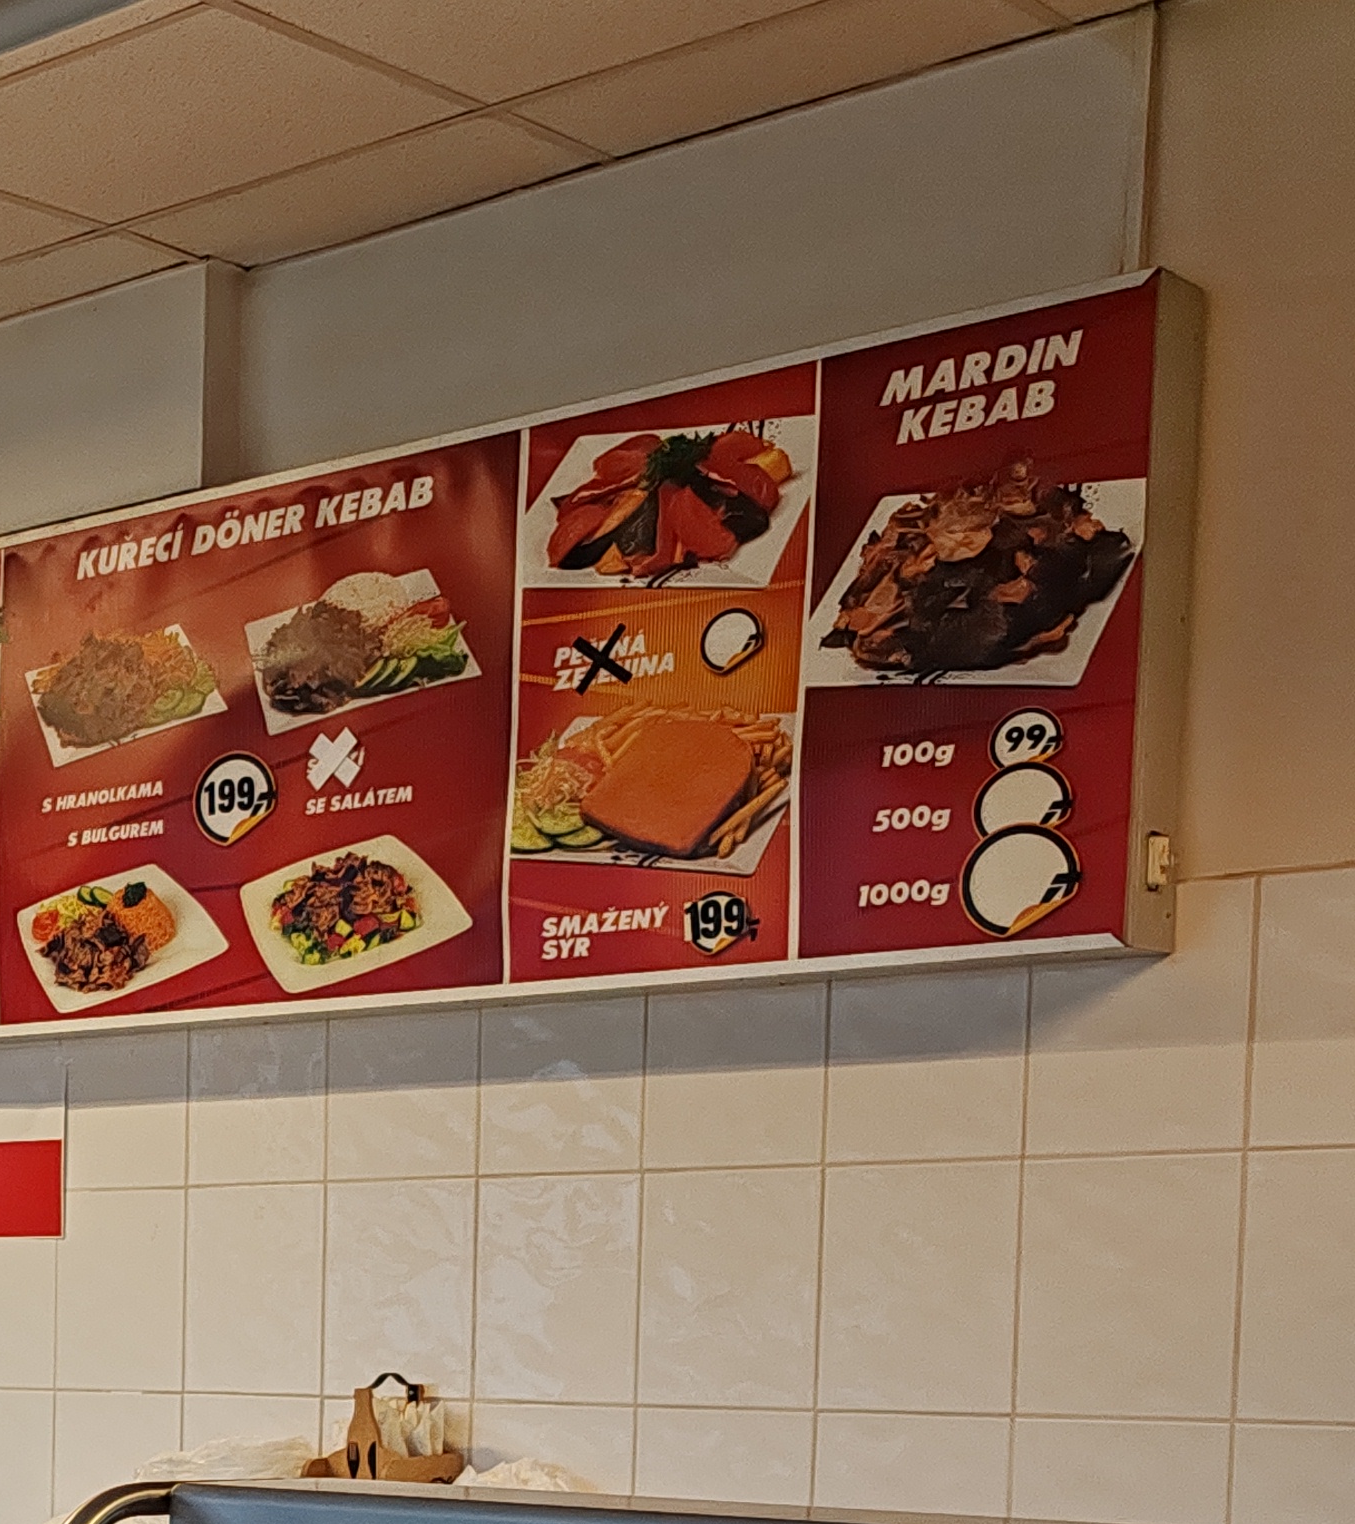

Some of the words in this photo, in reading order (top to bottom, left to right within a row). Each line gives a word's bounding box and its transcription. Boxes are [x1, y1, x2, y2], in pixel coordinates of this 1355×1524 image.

[879, 329, 1084, 407] MARDIN
[896, 380, 1056, 446] KEBAB
[76, 523, 184, 580] KUŘECÍ
[191, 508, 305, 556] DÖNER
[315, 476, 435, 528] KEBAB
[882, 741, 955, 768] 100g
[42, 799, 53, 814] S
[55, 780, 164, 811] HRANOLKAMA
[305, 798, 325, 815] SE
[329, 786, 413, 812] SALÁTEM
[68, 831, 78, 847] S
[81, 820, 164, 845] BULGUREM
[872, 805, 951, 832] 500g
[858, 879, 950, 907] 1000g
[541, 902, 670, 938] SMAŽENÝ
